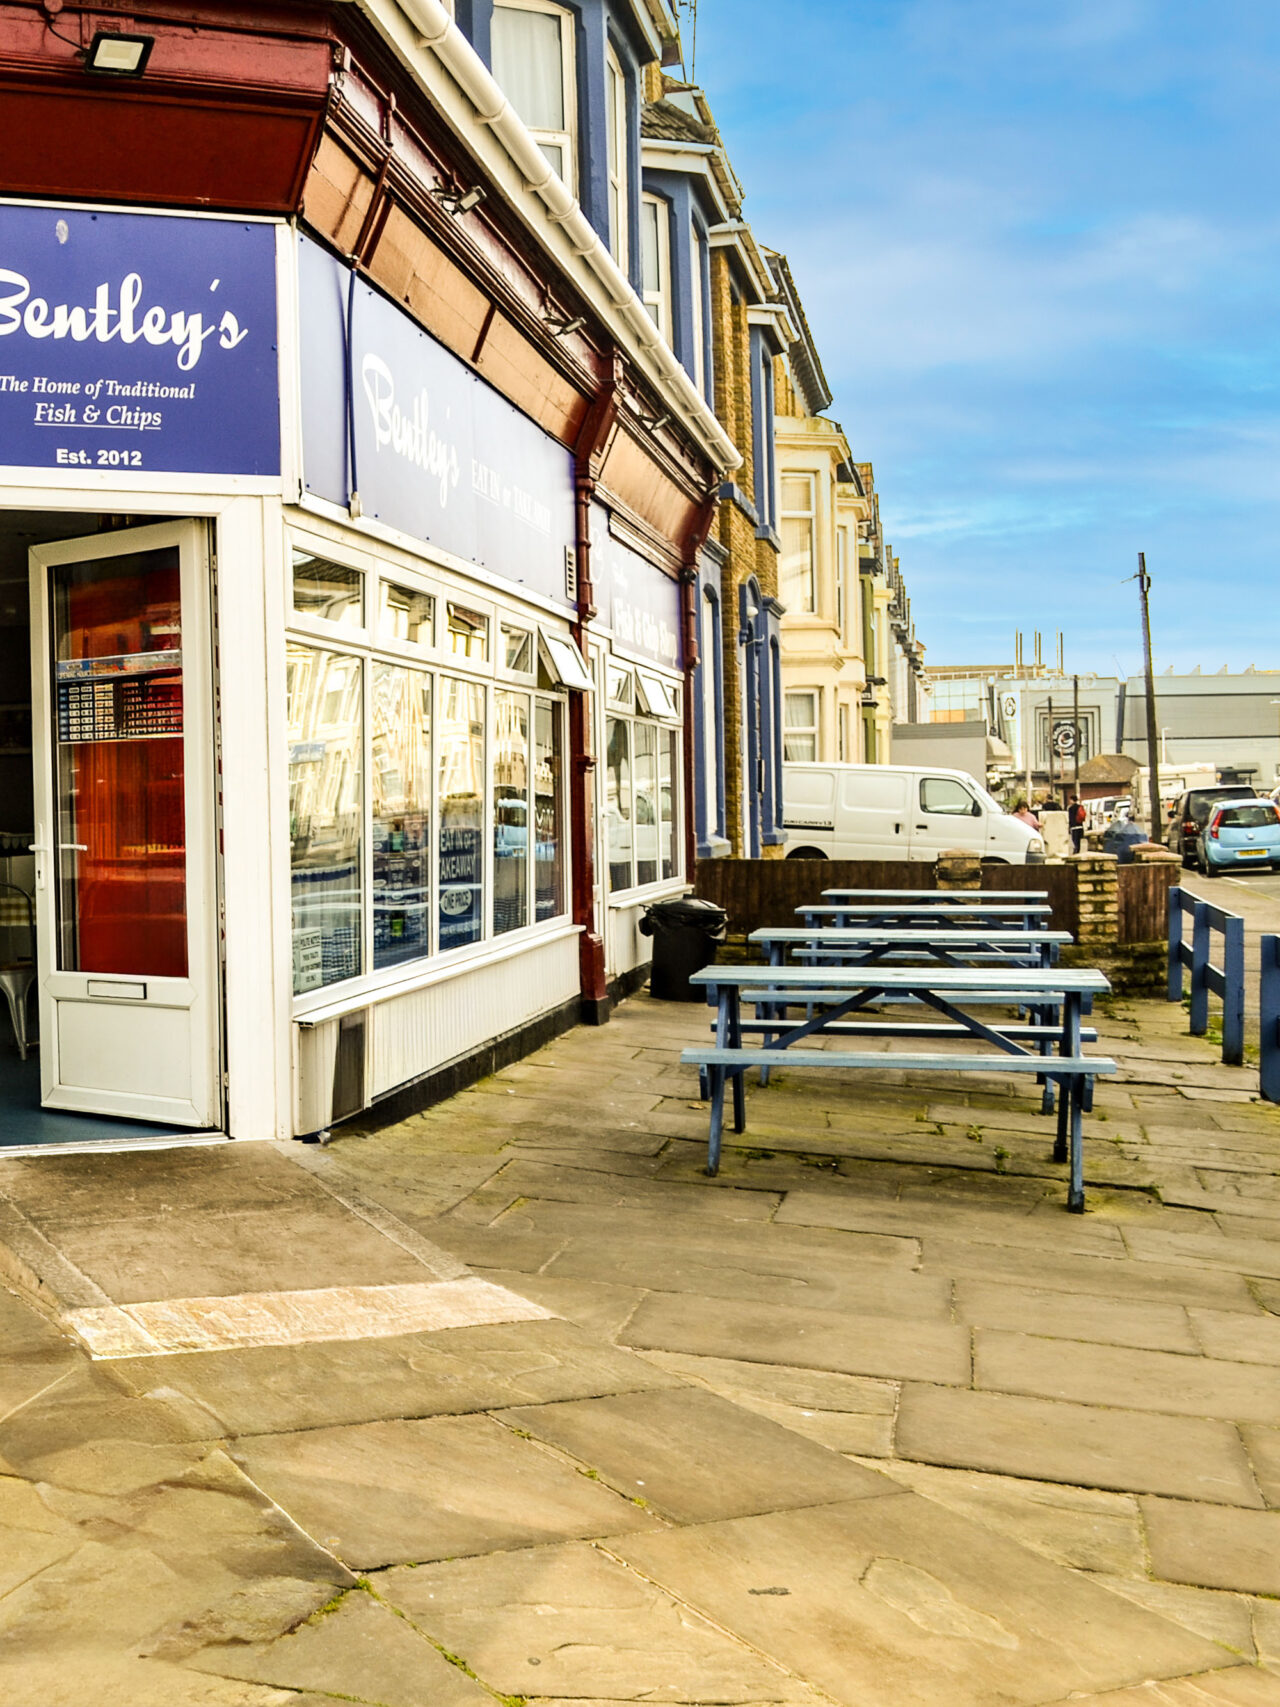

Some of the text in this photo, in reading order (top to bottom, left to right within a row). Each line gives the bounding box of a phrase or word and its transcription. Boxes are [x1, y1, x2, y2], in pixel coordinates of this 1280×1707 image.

[0, 376, 195, 400] The Home of Traditional
[34, 403, 162, 430] Fish & Chips
[362, 353, 460, 508] Bentley's
[56, 448, 142, 466] Est. 2012
[439, 853, 476, 880] AKEAWAY
